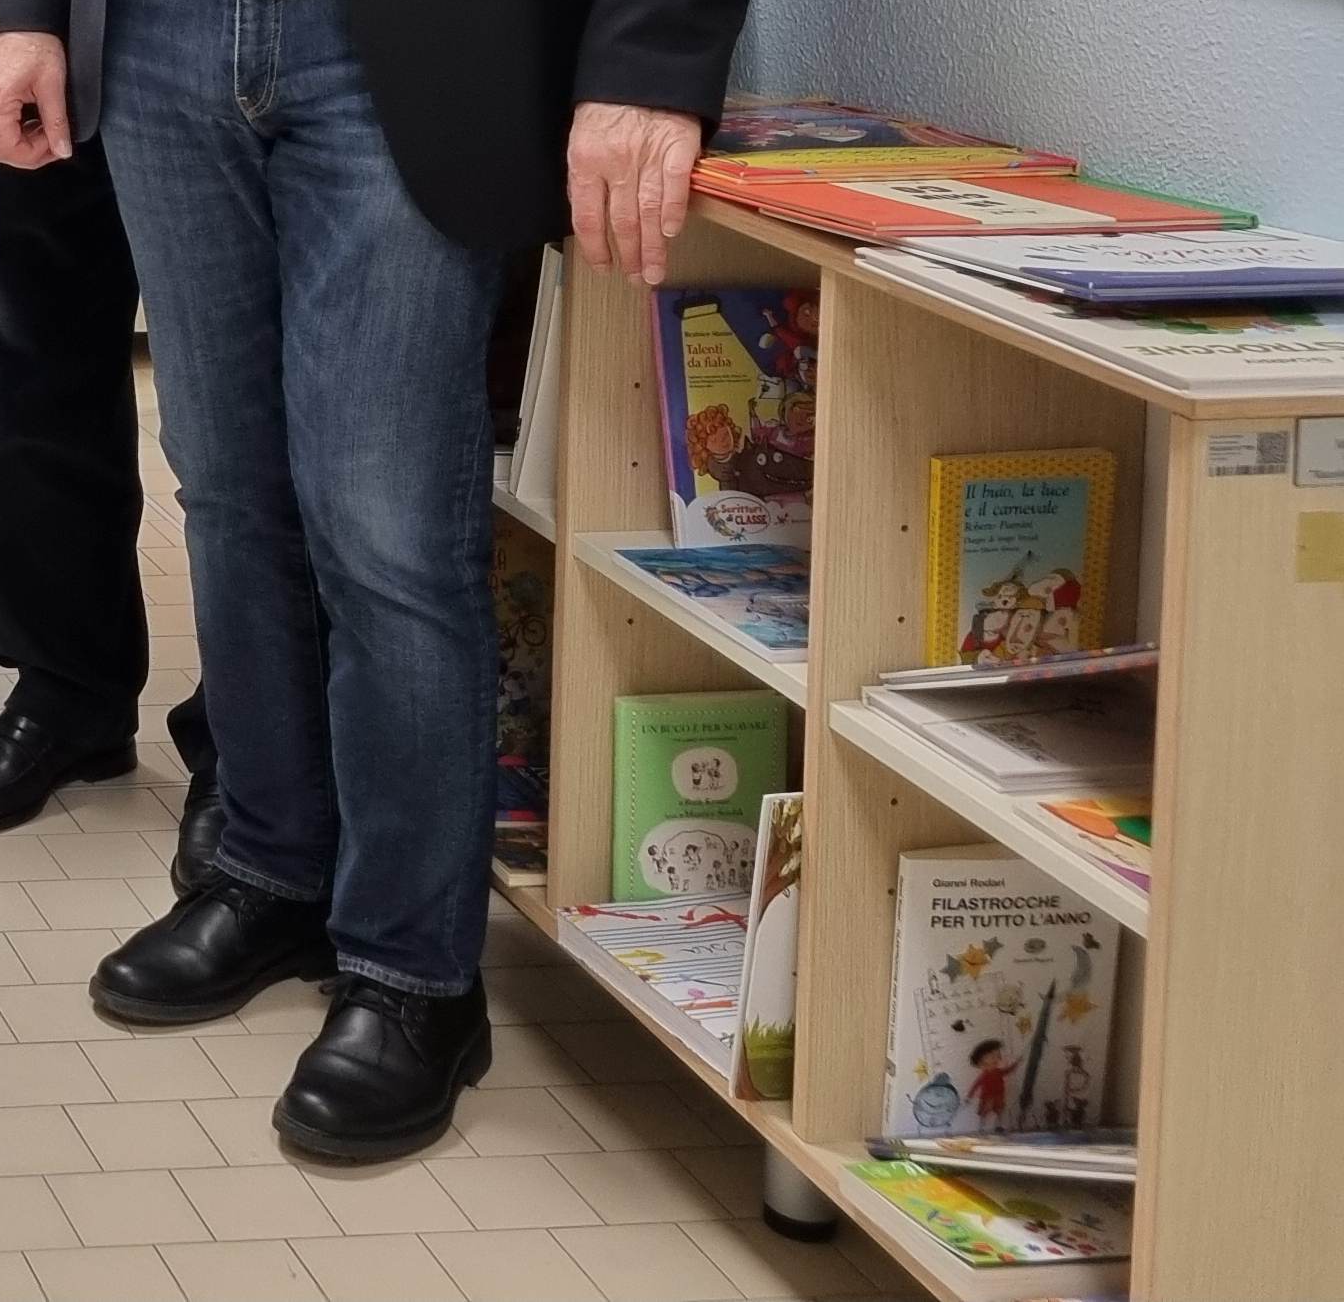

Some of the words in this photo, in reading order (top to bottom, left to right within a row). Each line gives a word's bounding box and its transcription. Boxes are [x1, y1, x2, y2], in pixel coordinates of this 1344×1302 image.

[685, 343, 724, 356] Talenti
[687, 357, 701, 368] da
[704, 356, 732, 369] fiaba
[966, 483, 977, 499] Il
[983, 482, 1014, 499] buio,
[1022, 482, 1035, 497] la
[1041, 481, 1070, 497] luce
[721, 503, 763, 515] Scrittori
[964, 507, 971, 518] e
[978, 503, 987, 517] il
[992, 500, 1059, 517] carnevale
[735, 514, 768, 526] CLASSE
[641, 724, 658, 734] UN
[932, 878, 967, 888] Gianni
[970, 877, 1005, 888] Rodari
[932, 895, 1060, 911] FILASTROCCHE
[931, 915, 965, 928] PER
[970, 913, 1025, 928] TUTTO
[1030, 911, 1092, 926] L'ANNO
